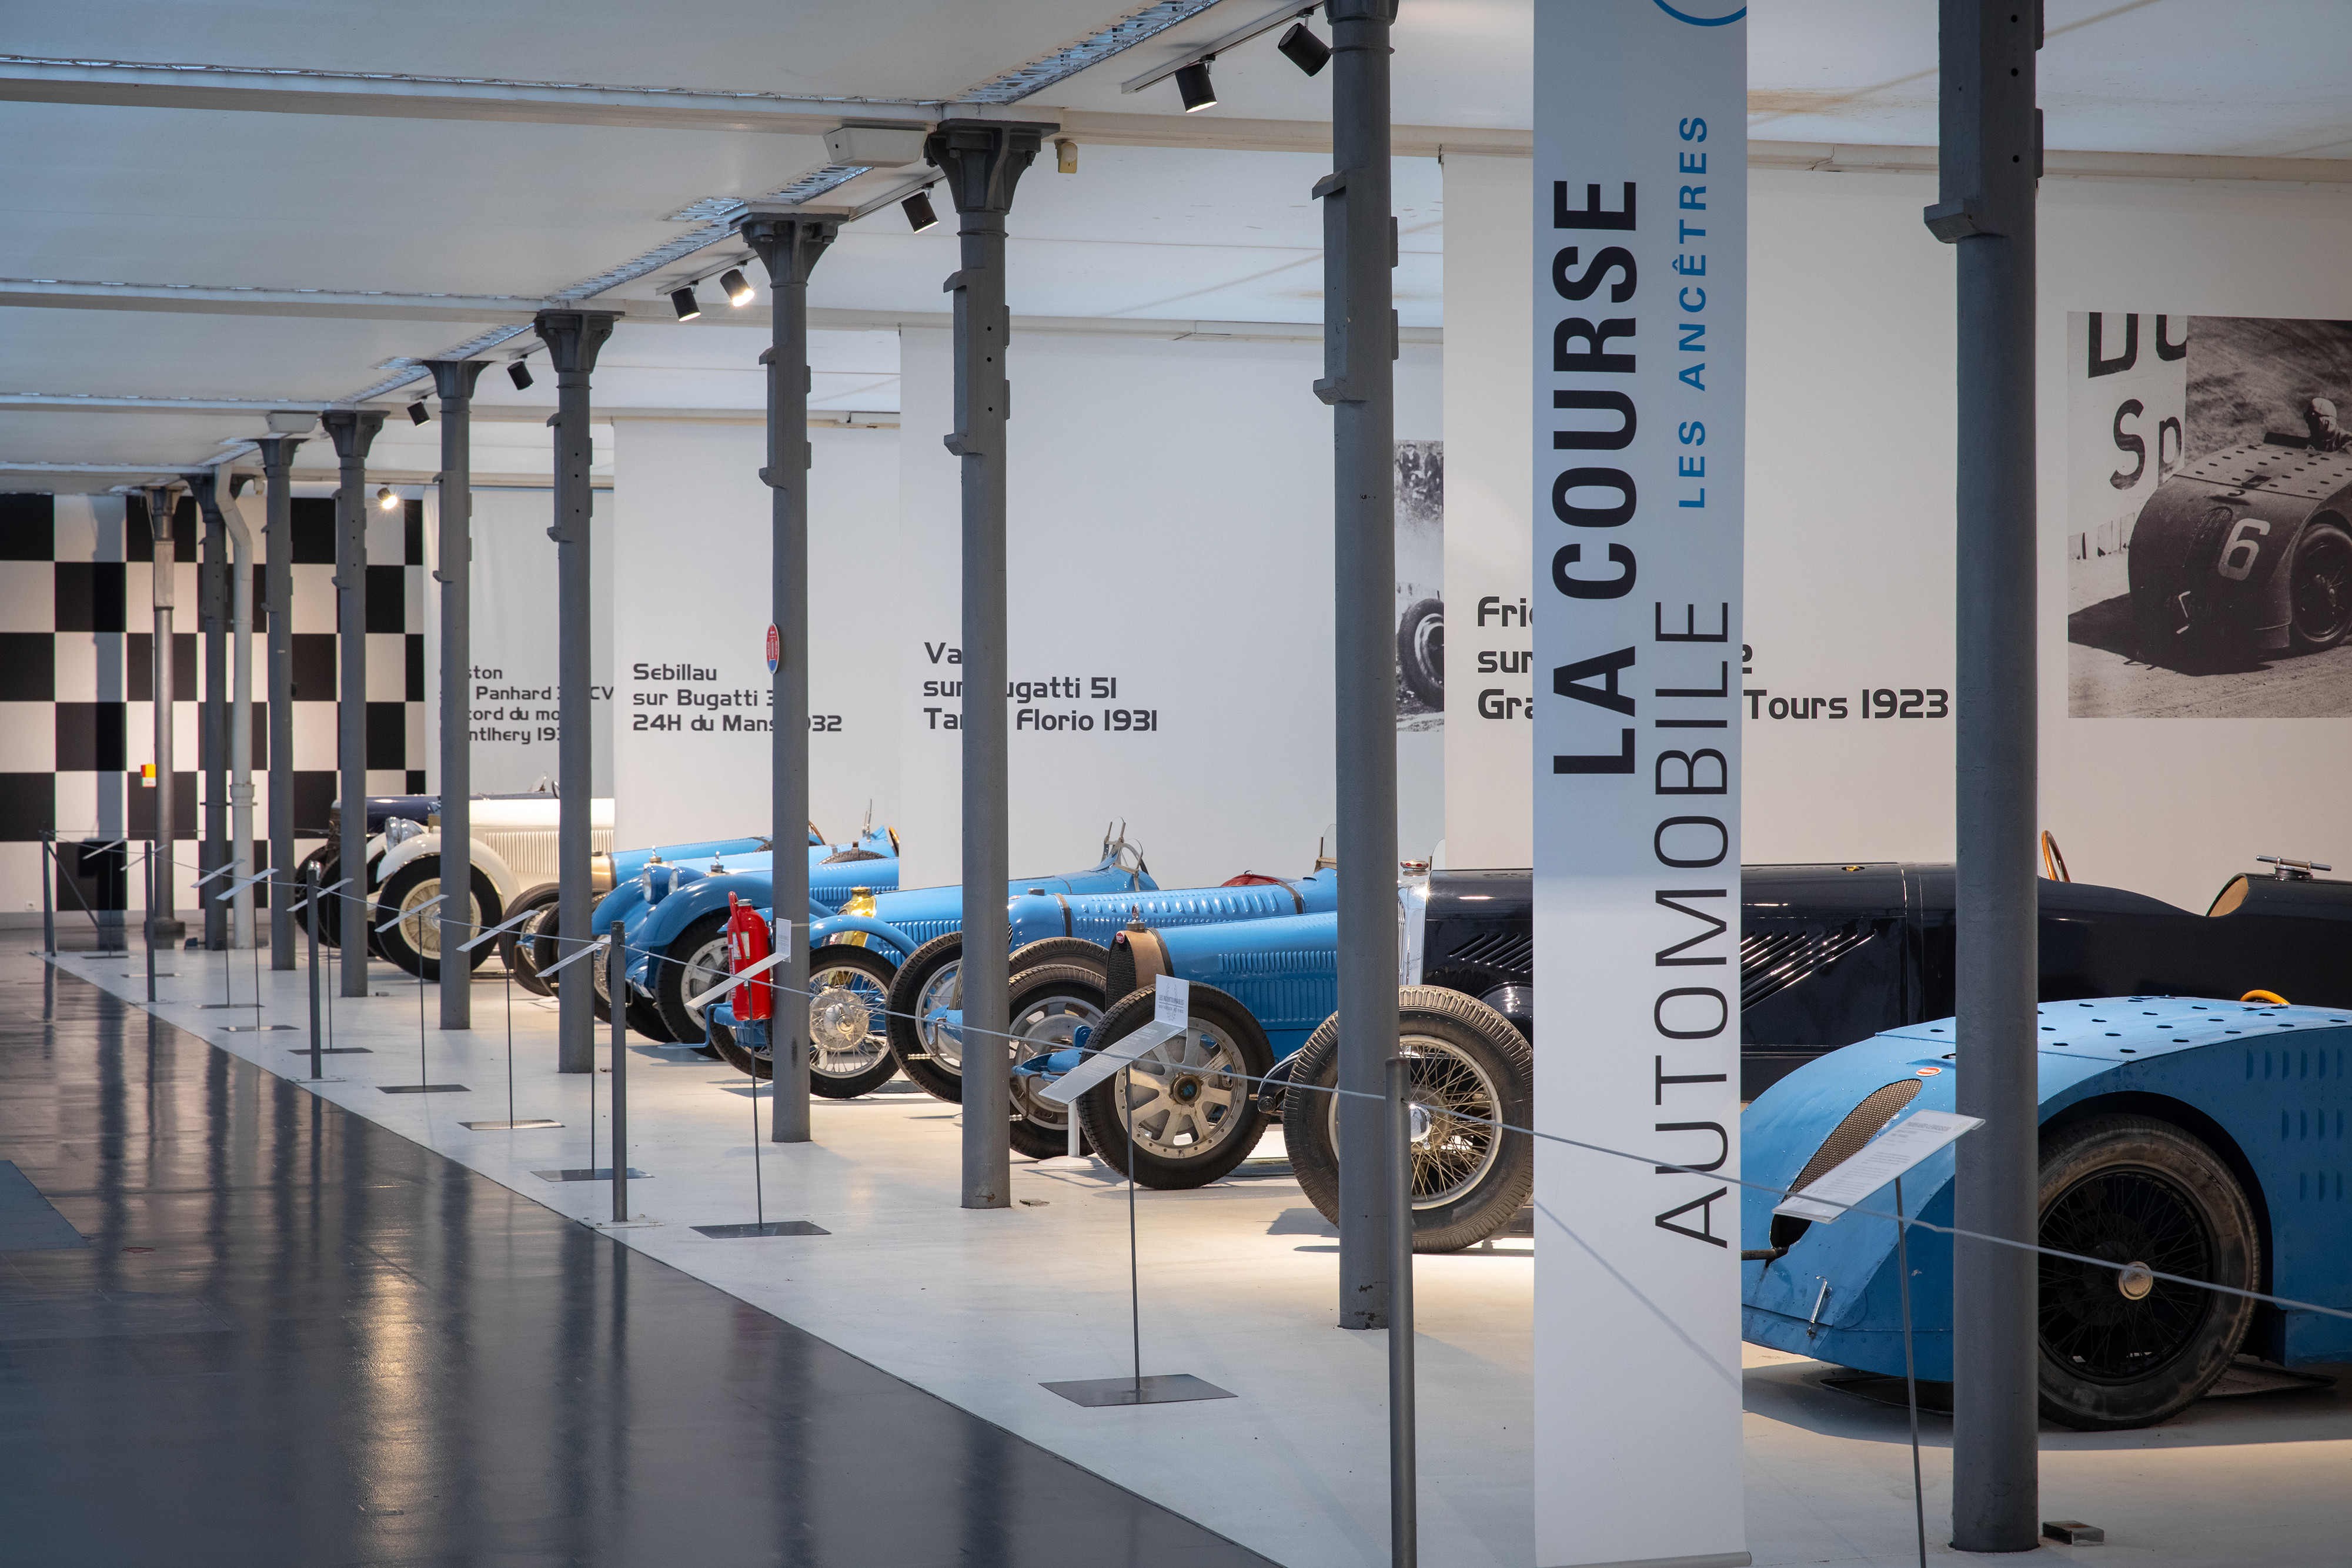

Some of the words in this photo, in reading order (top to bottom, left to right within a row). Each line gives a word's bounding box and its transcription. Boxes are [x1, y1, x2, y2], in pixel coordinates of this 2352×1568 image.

[1672, 117, 1708, 392] ANCÊTRES
[1552, 180, 1638, 600] COURSE
[1678, 421, 1706, 508] LES
[2218, 518, 2271, 581] 6
[1478, 596, 1532, 627] Fri
[924, 642, 962, 664] Va
[633, 663, 717, 681] Sebillau
[476, 686, 552, 700] Panhard
[633, 693, 669, 706] sur
[677, 689, 758, 710] Bugatti
[1091, 677, 1117, 699] 51
[509, 707, 529, 721] du
[536, 710, 559, 721] mo
[1553, 646, 1636, 774] LA
[1743, 689, 1848, 720] Tours
[1862, 688, 1949, 719] 1923
[633, 714, 681, 731] 24H
[690, 714, 714, 731] du
[808, 715, 841, 732] 32
[1017, 708, 1094, 731] Florio
[1104, 709, 1157, 731] 1931
[469, 727, 531, 745] ntlhery
[1654, 601, 1729, 1249] AUTOMOBILE
[1417, 1015, 1509, 1079] MICHELIN
